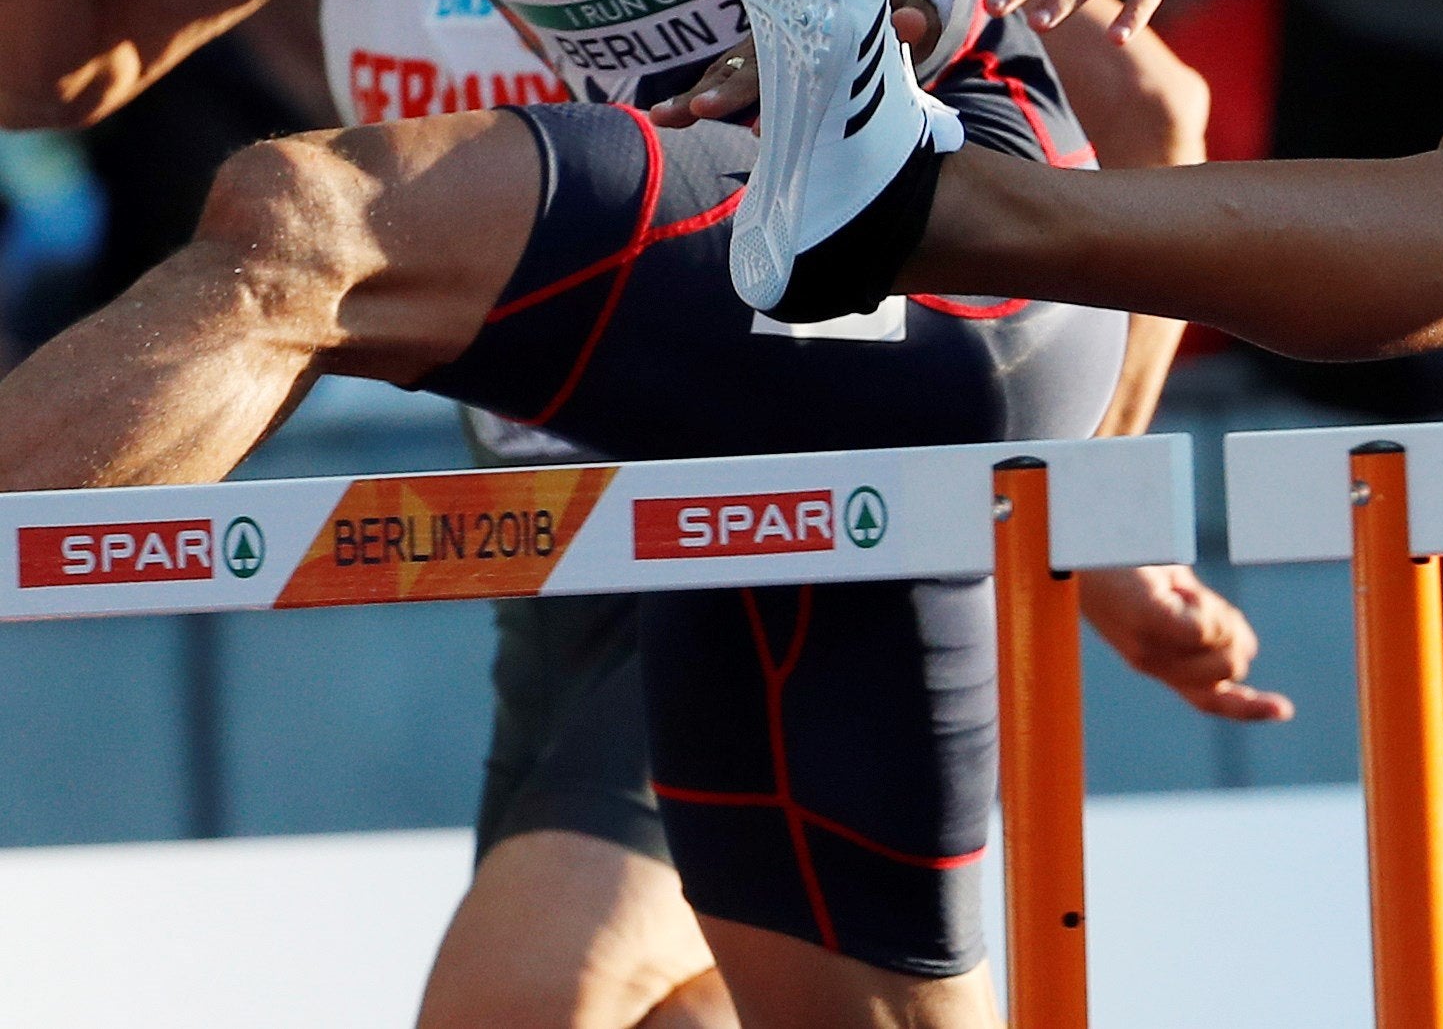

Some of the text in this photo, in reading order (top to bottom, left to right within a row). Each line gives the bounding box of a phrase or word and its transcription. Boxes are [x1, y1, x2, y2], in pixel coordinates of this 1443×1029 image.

[556, 11, 719, 70] BERLIN
[565, 7, 580, 27] I
[335, 509, 554, 566] BERLIN 2018
[677, 500, 833, 548] SPAR
[61, 529, 211, 575] SPAR
